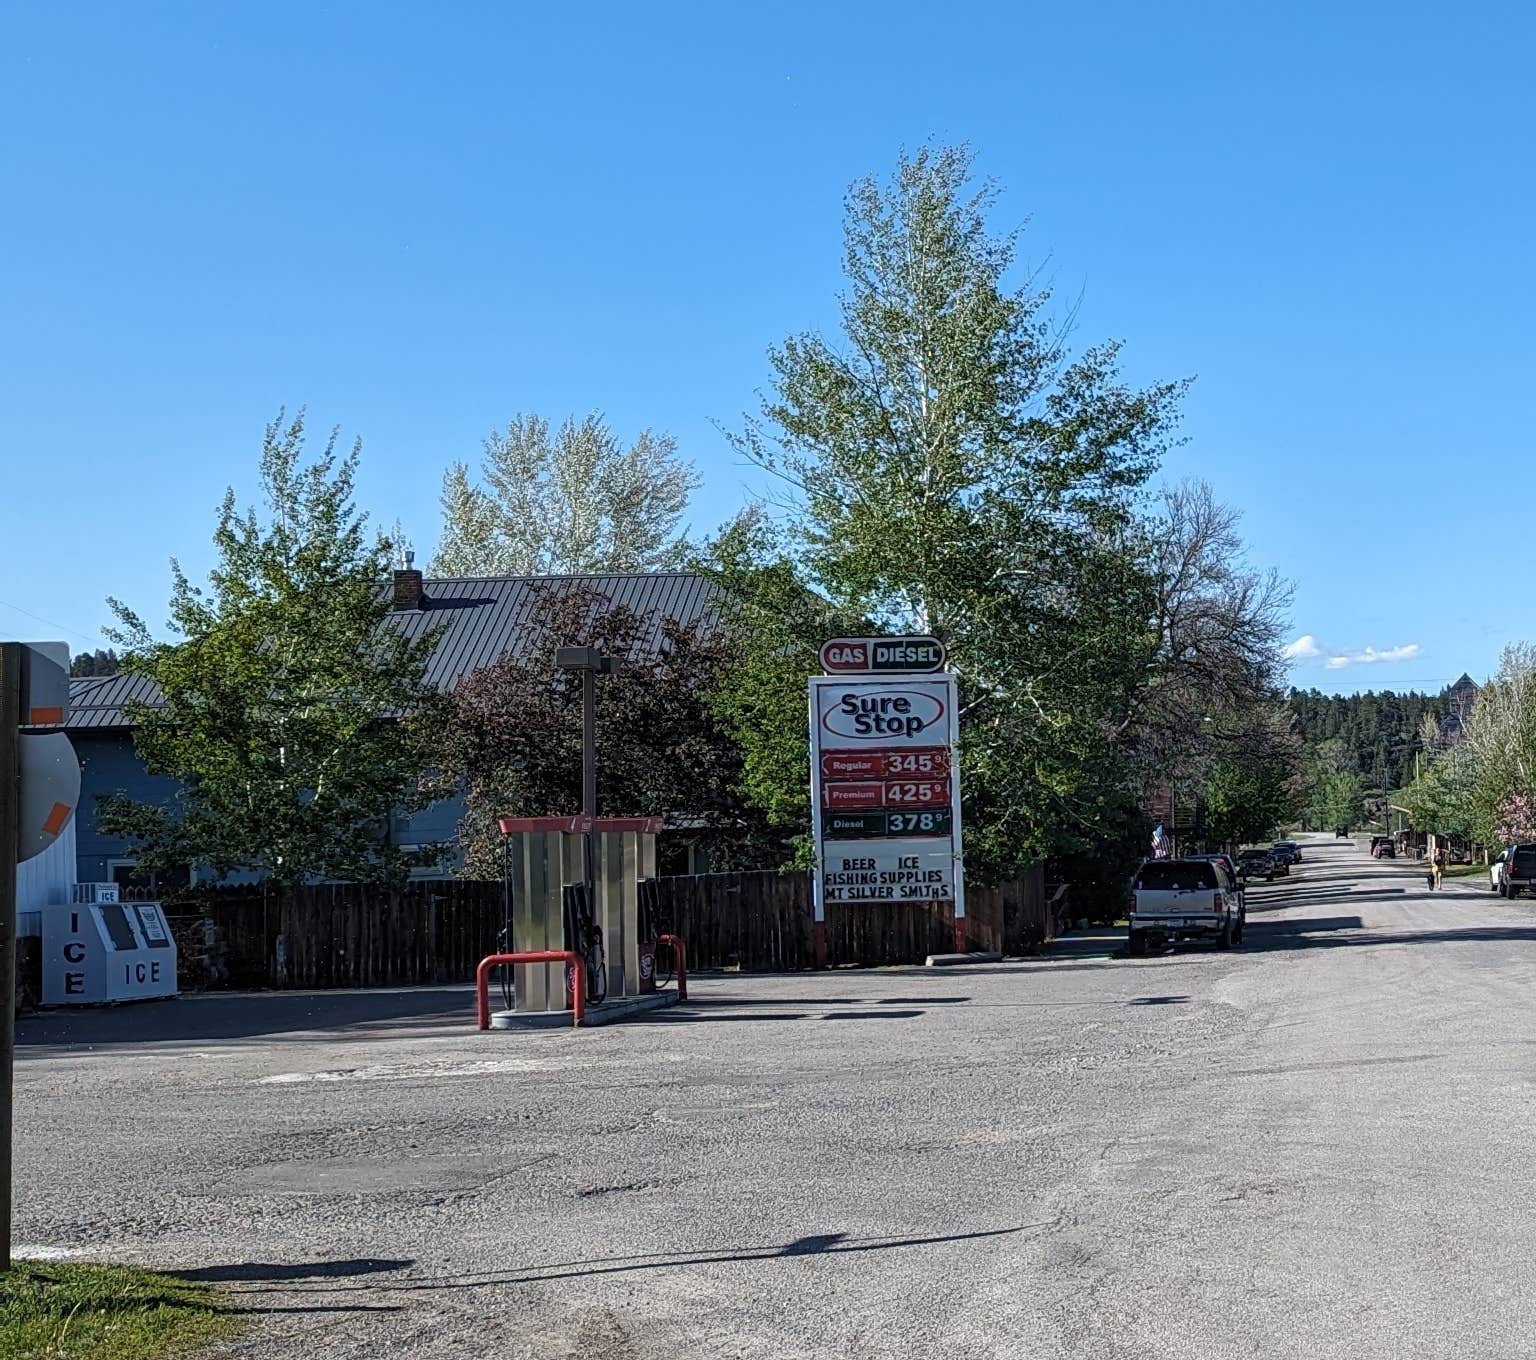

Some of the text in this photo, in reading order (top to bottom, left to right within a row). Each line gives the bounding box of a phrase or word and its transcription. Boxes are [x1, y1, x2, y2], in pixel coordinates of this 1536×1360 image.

[828, 646, 938, 663] GAS DIESEL
[841, 693, 911, 715] Sure
[855, 713, 924, 737] Stop
[833, 761, 872, 771] Regular
[833, 791, 875, 799] Premium
[834, 819, 864, 828] Diesel
[843, 856, 919, 870] BEER ICE
[825, 870, 942, 885] FISHING SUPPLIES
[102, 892, 114, 901] ICE
[825, 884, 948, 900] MT SILVER SMITHS
[64, 913, 86, 994] ICE
[126, 961, 159, 984] ICE
